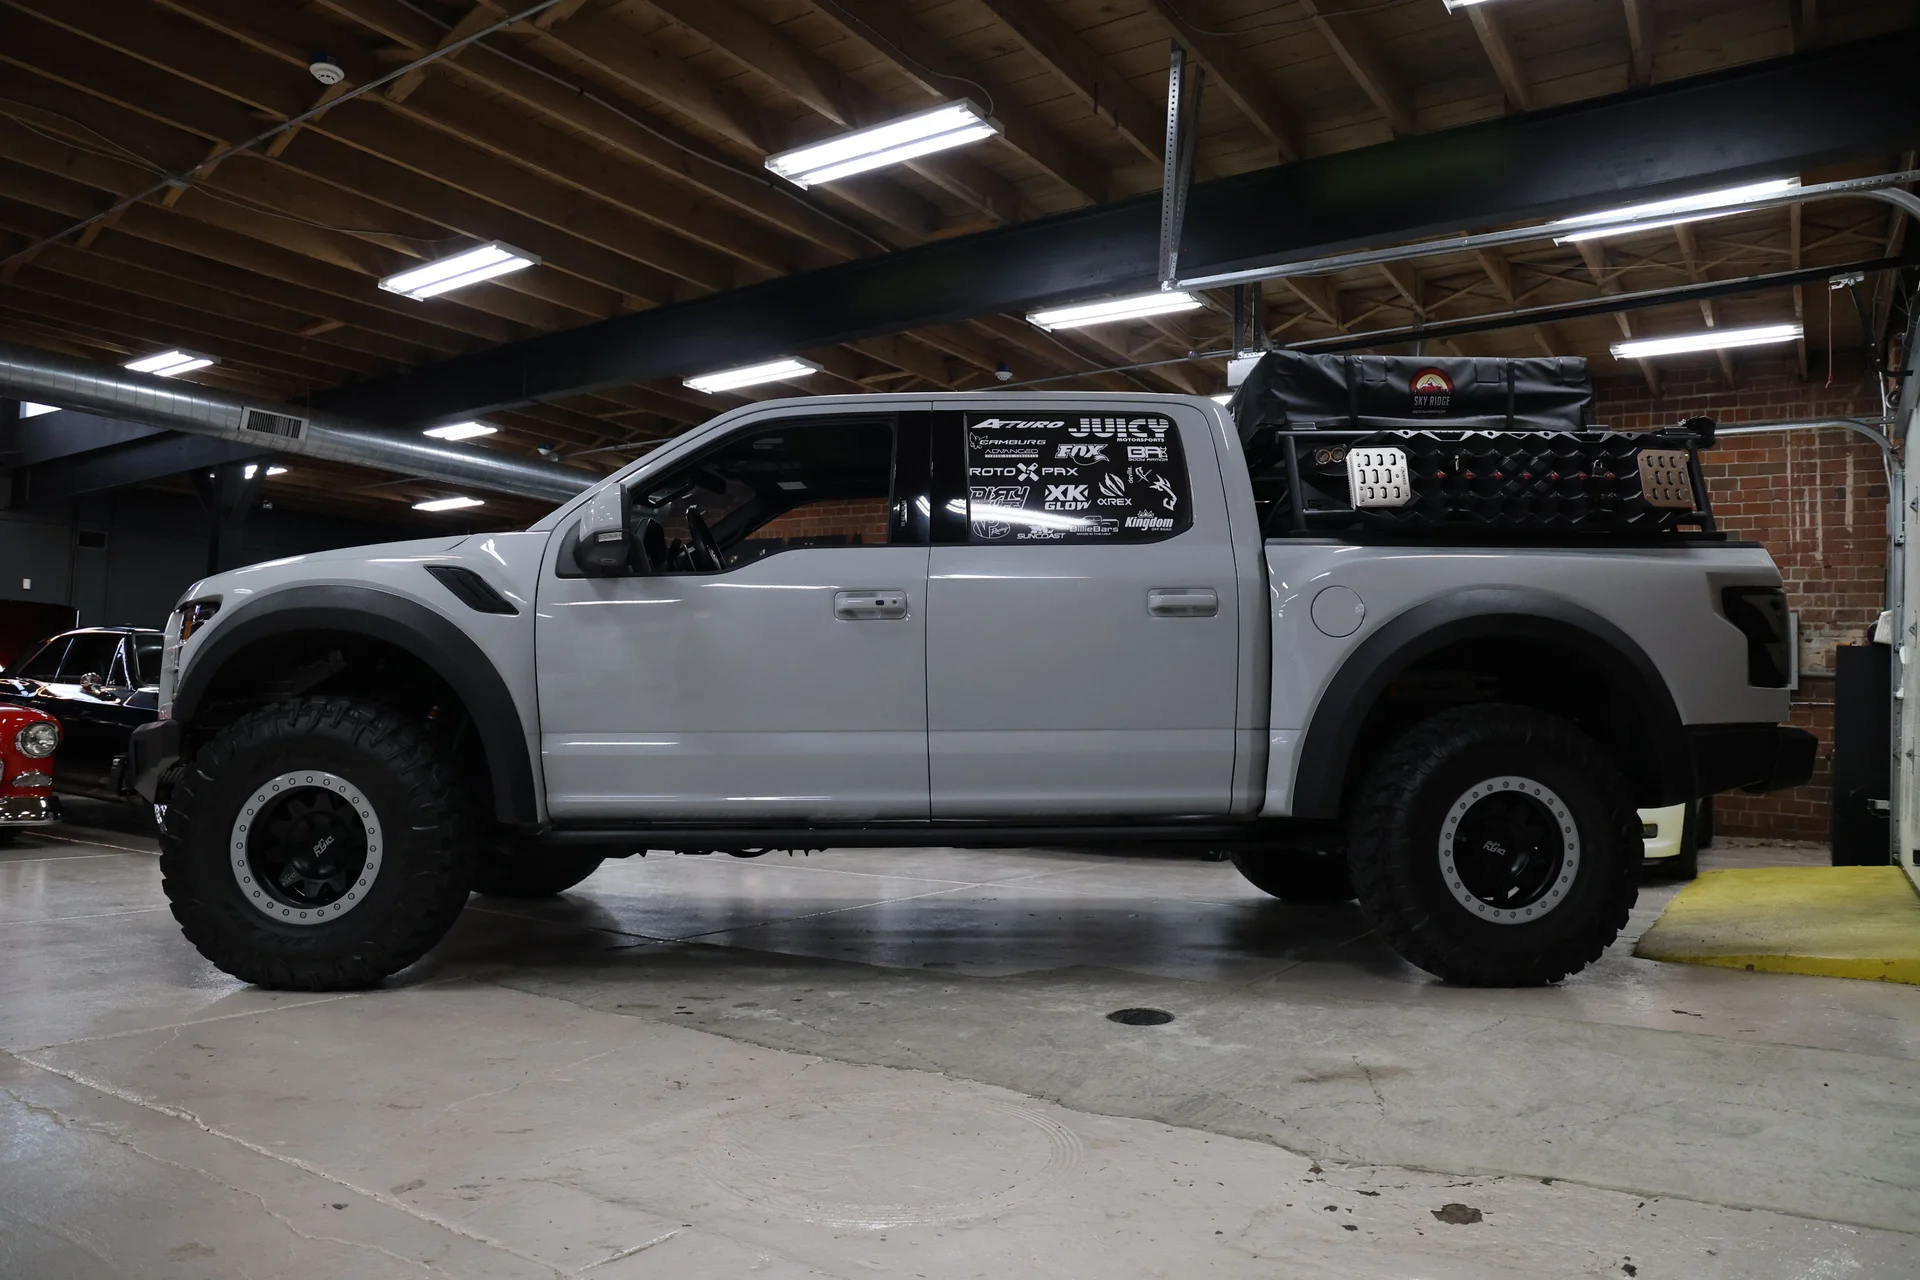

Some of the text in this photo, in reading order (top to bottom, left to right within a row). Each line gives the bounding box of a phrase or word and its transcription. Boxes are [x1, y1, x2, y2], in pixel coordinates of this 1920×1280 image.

[1413, 395, 1451, 406] SKY RIDGE
[971, 418, 1065, 429] ATTURO
[1068, 418, 1169, 438] JUICY
[1055, 443, 1108, 459] FOX
[969, 467, 1079, 476] ROTO PAX
[1045, 484, 1088, 501] XK
[1044, 500, 1091, 511] GLOW
[1124, 516, 1174, 531] Kingdom
[1017, 532, 1066, 540] SUNCOAST
